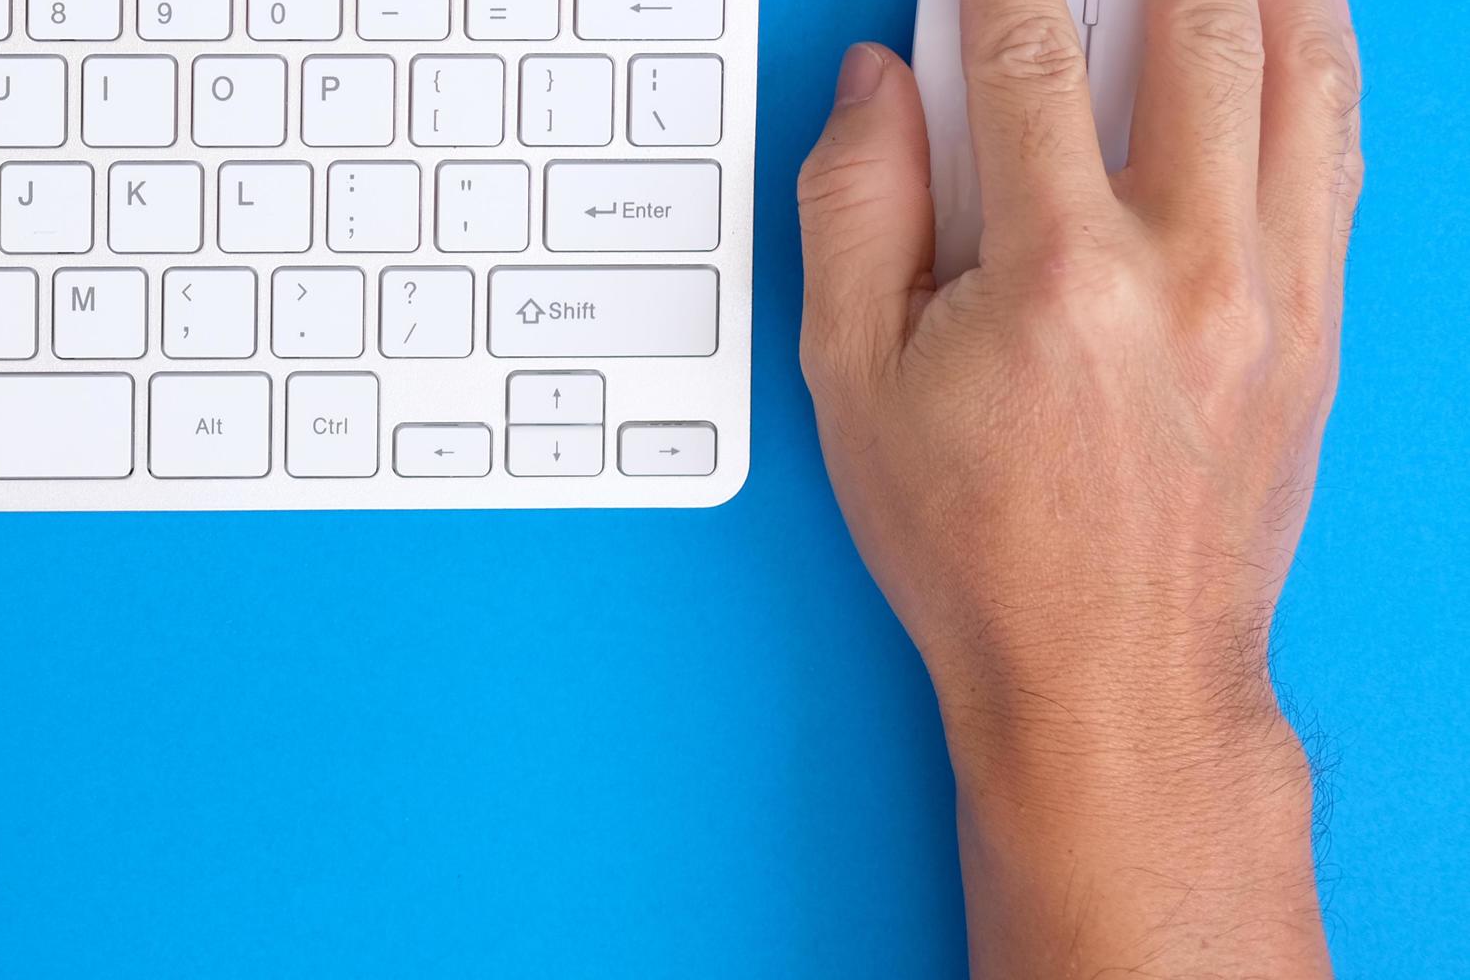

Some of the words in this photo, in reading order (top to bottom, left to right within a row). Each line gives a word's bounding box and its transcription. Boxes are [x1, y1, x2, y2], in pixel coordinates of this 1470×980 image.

[51, 2, 66, 24] 8
[158, 3, 172, 24] 9
[271, 3, 285, 24] 0
[490, 8, 506, 19] =
[212, 76, 234, 101] O
[322, 76, 340, 101] P
[433, 69, 441, 93] {
[546, 69, 555, 93] }
[546, 108, 553, 132] ]
[18, 181, 33, 206] J
[128, 181, 146, 205] K
[238, 181, 254, 205] L
[623, 202, 672, 218] Enter
[348, 216, 355, 240] ;
[72, 287, 95, 311] M
[182, 284, 191, 301] <
[298, 283, 307, 300] >
[404, 282, 416, 304] ?
[549, 302, 595, 319] Shift
[404, 323, 416, 343] /
[196, 418, 222, 434] Alt
[313, 417, 347, 434] Ctrl
